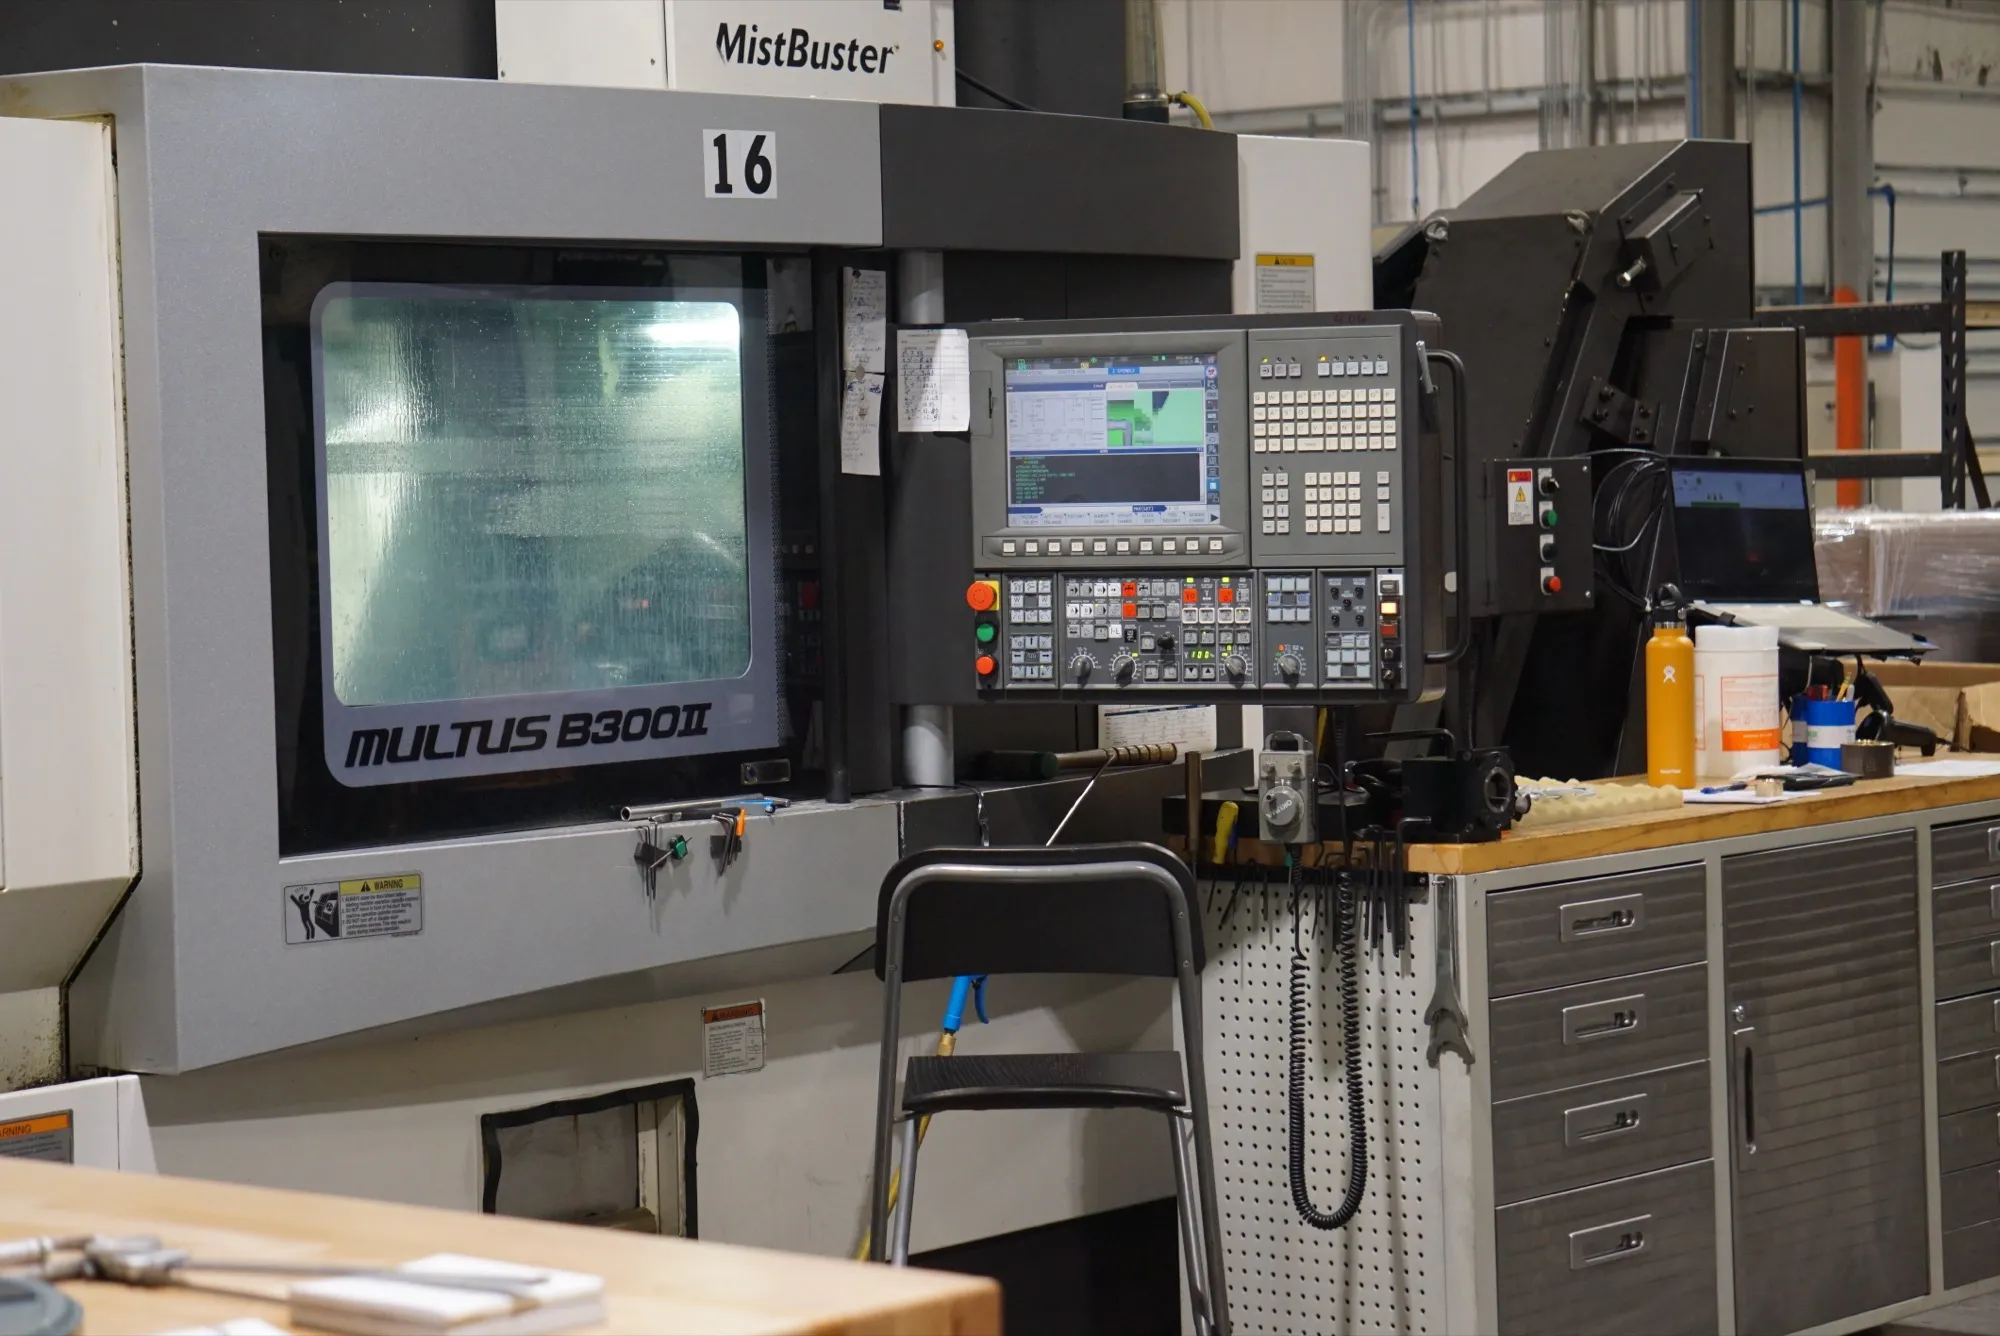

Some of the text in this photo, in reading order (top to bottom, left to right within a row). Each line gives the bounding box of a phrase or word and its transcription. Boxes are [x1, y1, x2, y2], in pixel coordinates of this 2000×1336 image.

[716, 22, 894, 74] MistBuster
[713, 133, 772, 194] 16
[344, 715, 550, 768] MULTUS
[374, 879, 403, 890] WARNING
[0, 1124, 32, 1137] RNING
